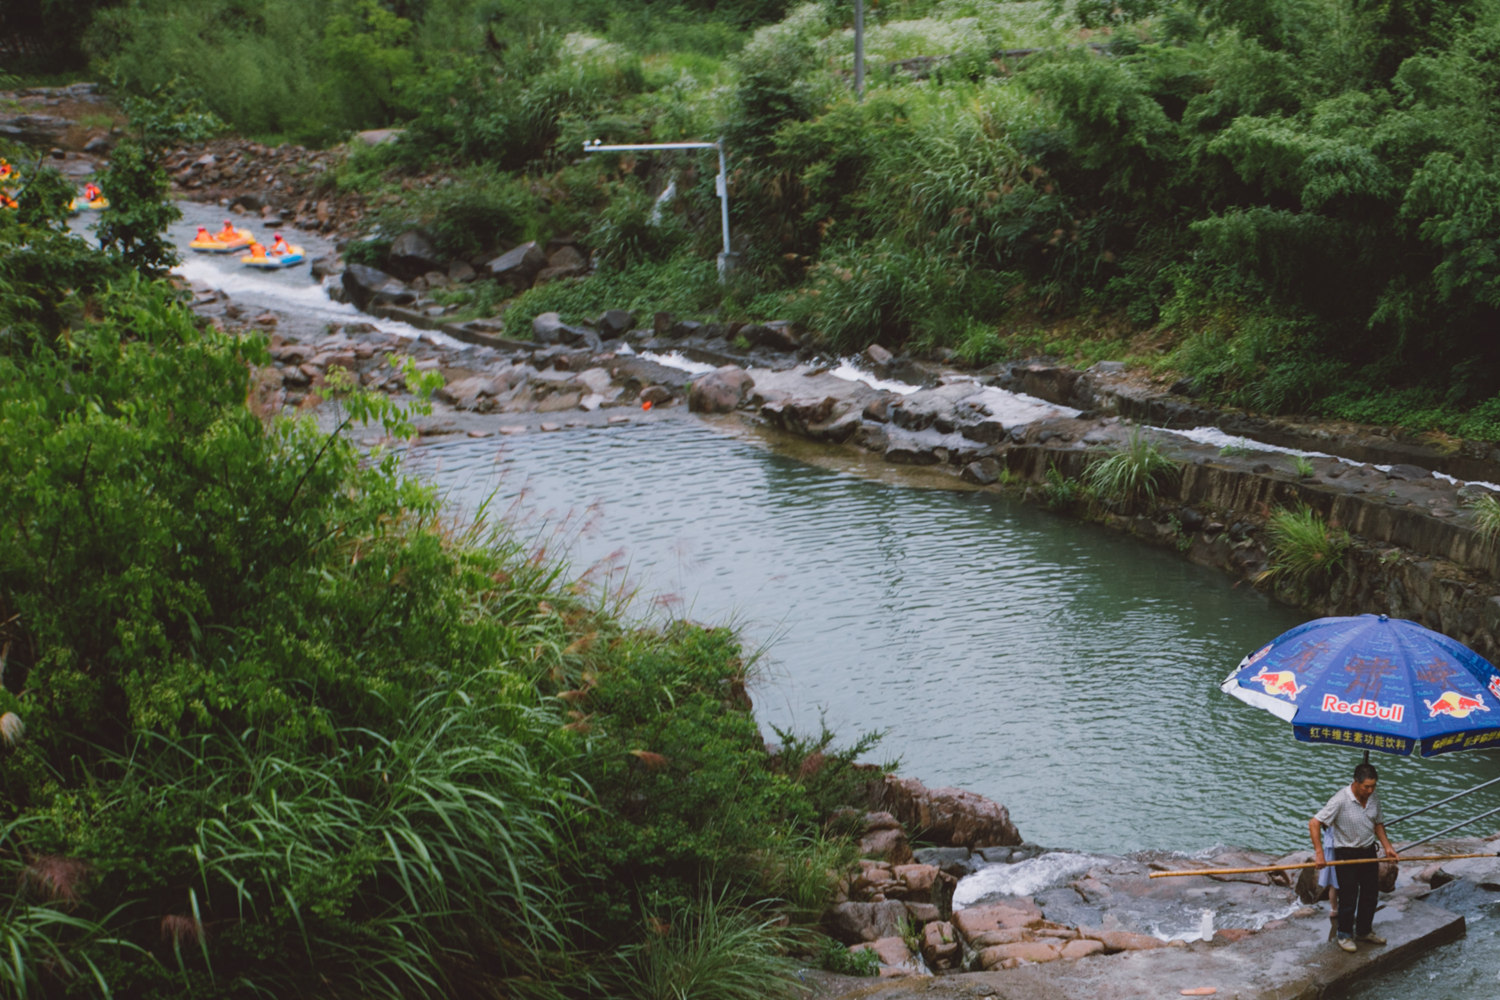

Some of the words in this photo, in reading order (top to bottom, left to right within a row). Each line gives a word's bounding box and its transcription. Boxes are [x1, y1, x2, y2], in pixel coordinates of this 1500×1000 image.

[1322, 694, 1404, 722] RedBull
[1309, 726, 1407, 751] 红牛维生素功能饮料
